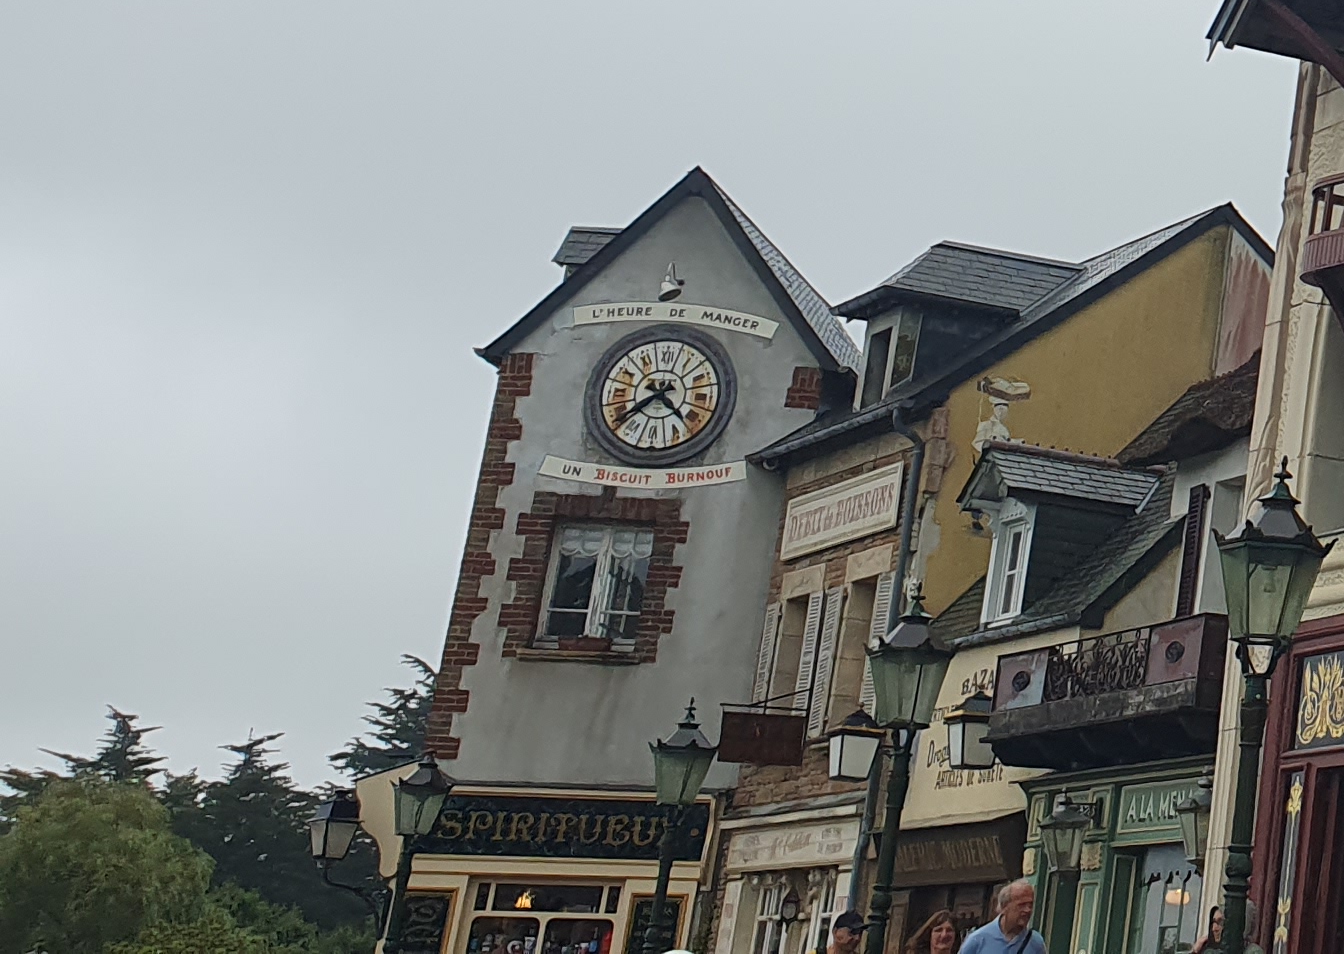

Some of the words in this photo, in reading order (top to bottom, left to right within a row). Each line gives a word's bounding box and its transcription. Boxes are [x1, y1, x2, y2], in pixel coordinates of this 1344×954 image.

[669, 308, 687, 318] DE
[701, 311, 760, 331] MANGER
[562, 464, 582, 477] UN
[594, 468, 652, 486] BISCUIT
[665, 467, 732, 485] BURNOUF
[1126, 795, 1136, 822] A
[436, 809, 674, 847] SPIRITUEU
